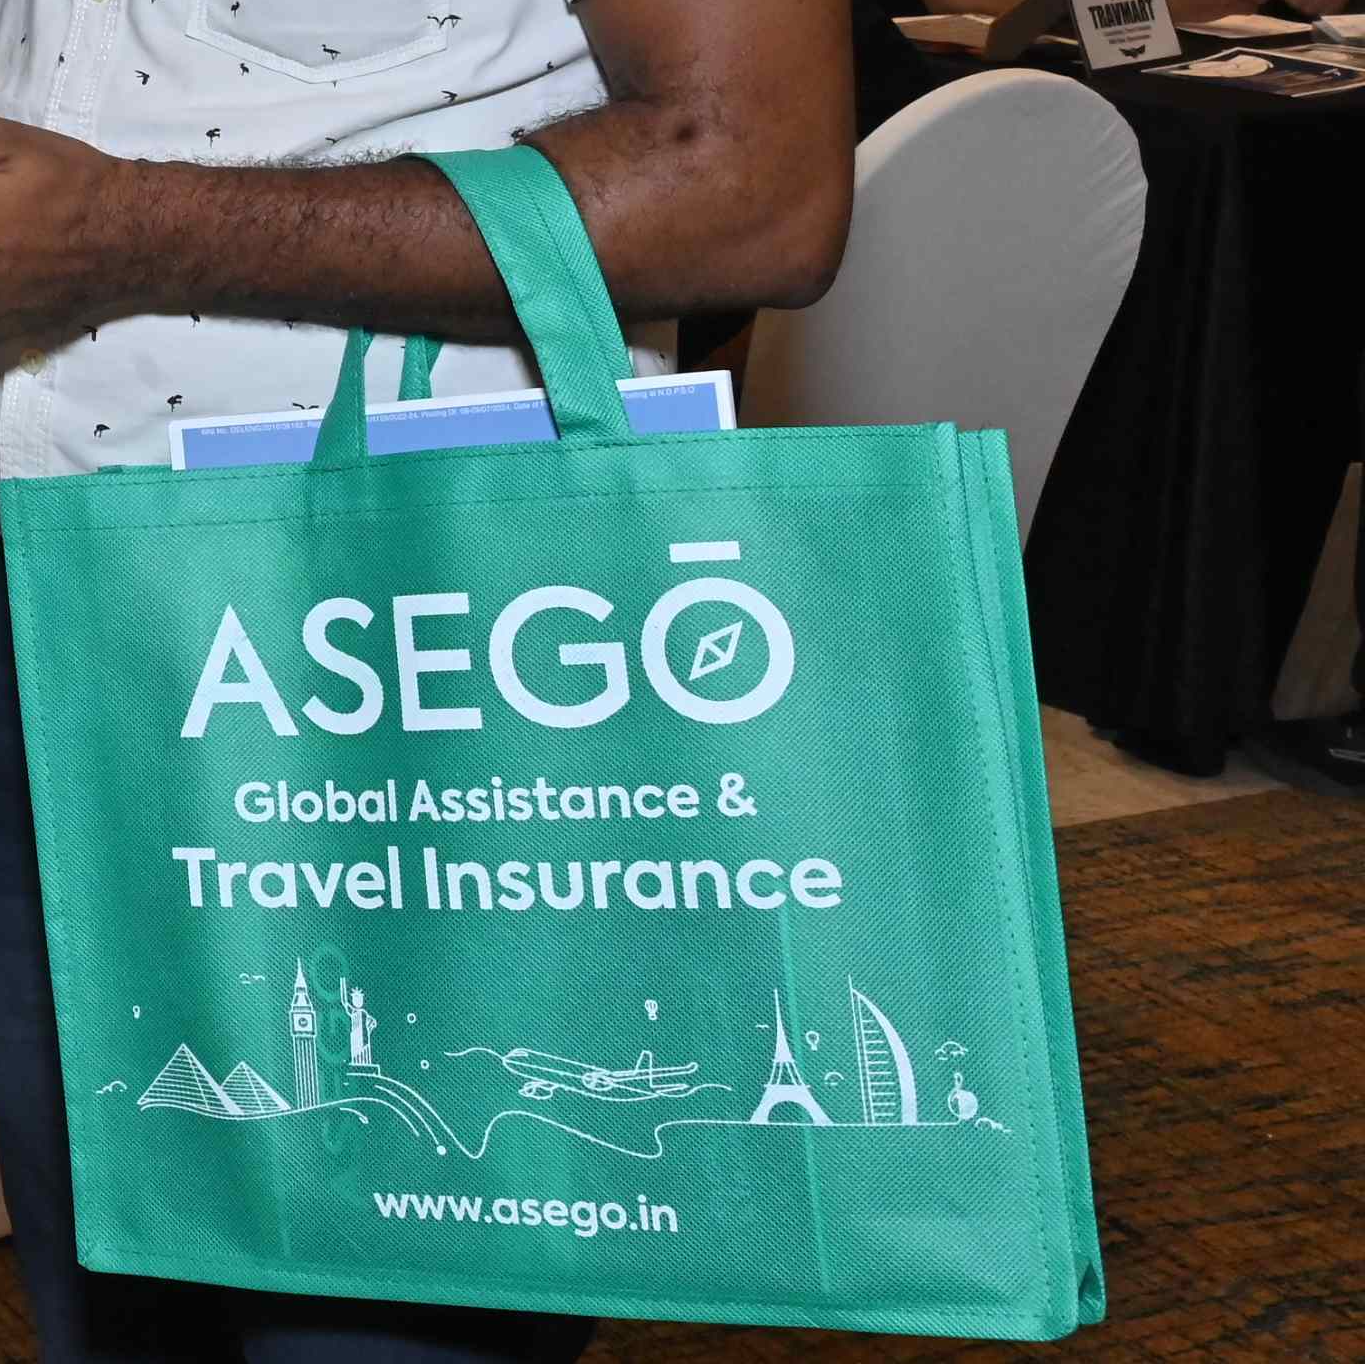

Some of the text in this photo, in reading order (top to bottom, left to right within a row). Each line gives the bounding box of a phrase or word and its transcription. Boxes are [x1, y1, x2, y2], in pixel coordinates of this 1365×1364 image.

[233, 772, 758, 825] Global Assistance &
[171, 844, 844, 911] Travel Insurance
[372, 1186, 680, 1234] www.asego.in
